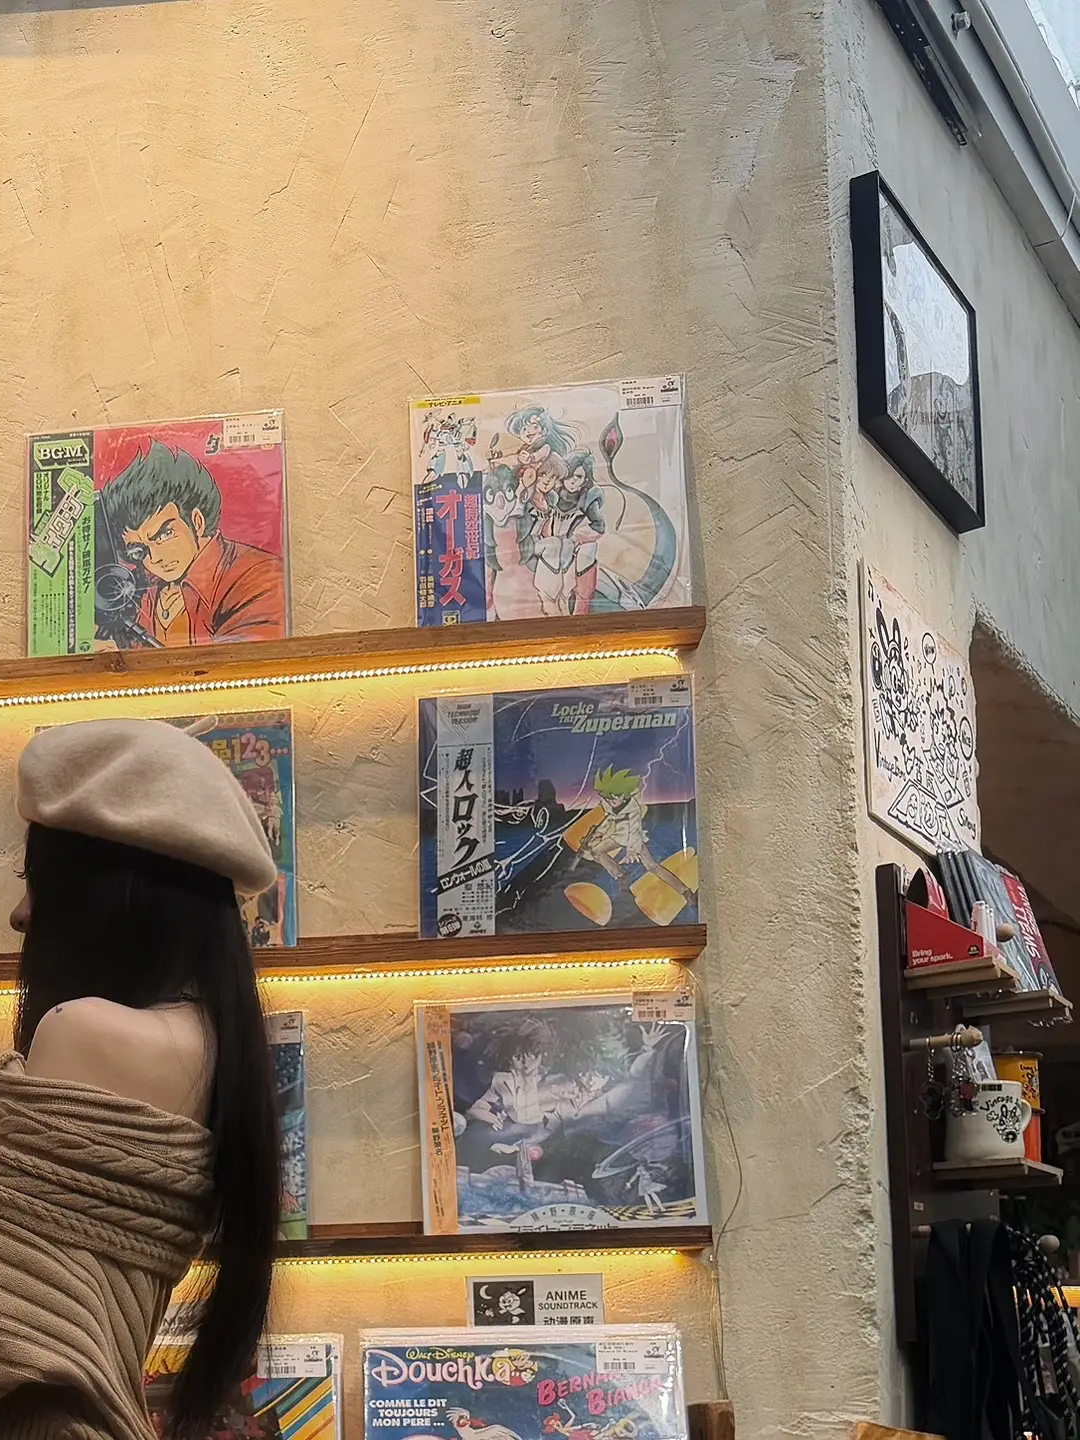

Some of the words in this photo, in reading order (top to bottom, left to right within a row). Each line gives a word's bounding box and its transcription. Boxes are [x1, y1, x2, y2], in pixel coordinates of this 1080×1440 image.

[39, 445, 83, 460] BGM
[436, 489, 466, 607] オーガス
[551, 701, 595, 717] Locke
[571, 712, 677, 736] Zuperman
[452, 747, 479, 869] 超人ロック
[912, 949, 932, 957] Bring
[912, 957, 929, 966] your
[930, 953, 954, 963] spark.
[545, 1290, 587, 1301] ANIME
[538, 1301, 598, 1310] SOUNDTRACK
[369, 1399, 412, 1408] COMME
[413, 1399, 426, 1408] LE
[427, 1398, 448, 1407] DIT
[378, 1409, 438, 1417] TOUJOURS
[372, 1418, 399, 1427] MON
[400, 1417, 431, 1427] PERE
